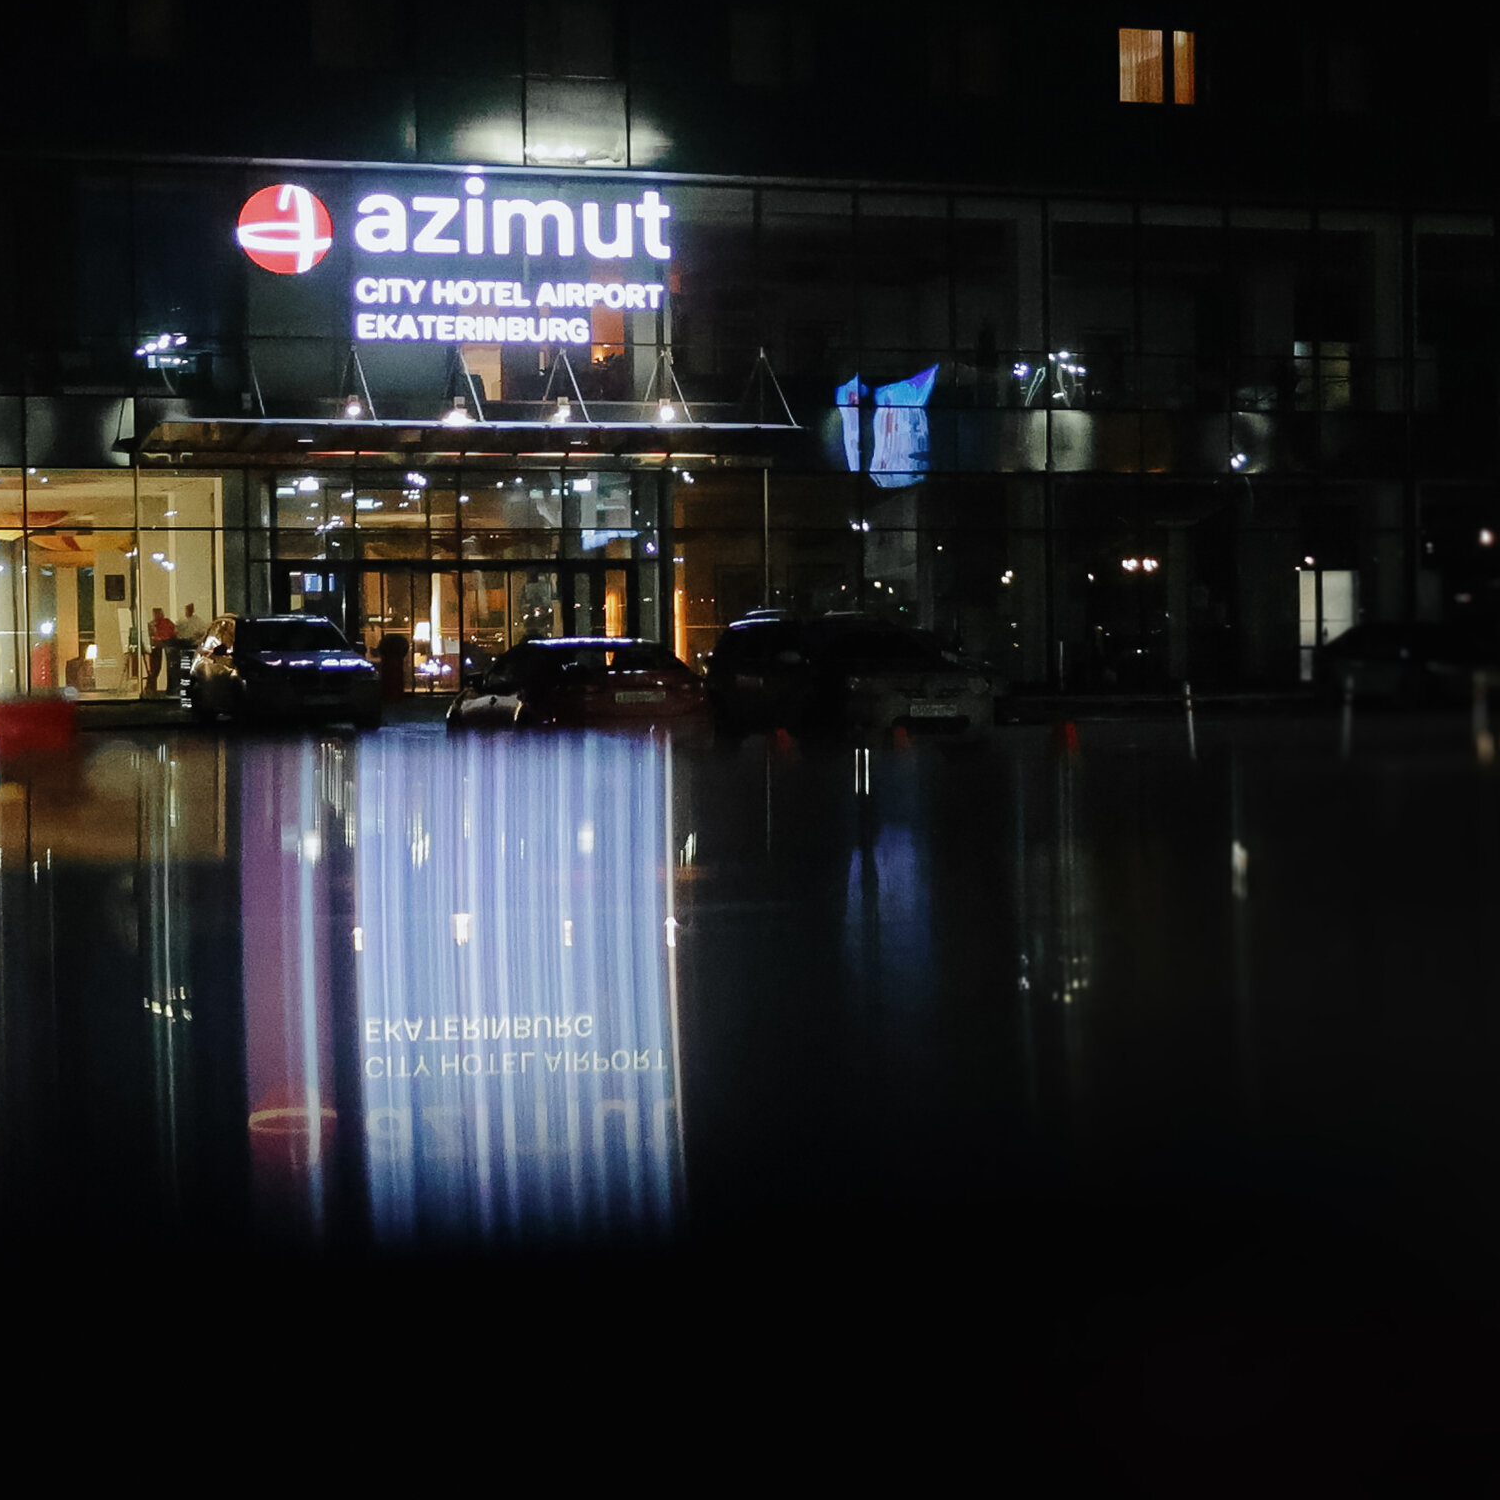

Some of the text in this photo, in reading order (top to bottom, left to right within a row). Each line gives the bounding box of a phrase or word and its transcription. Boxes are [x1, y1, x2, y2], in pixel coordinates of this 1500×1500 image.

[354, 176, 672, 260] azimut
[355, 277, 664, 310] CITY HOTEL AIRPORT
[355, 313, 591, 343] EKATERINBURG
